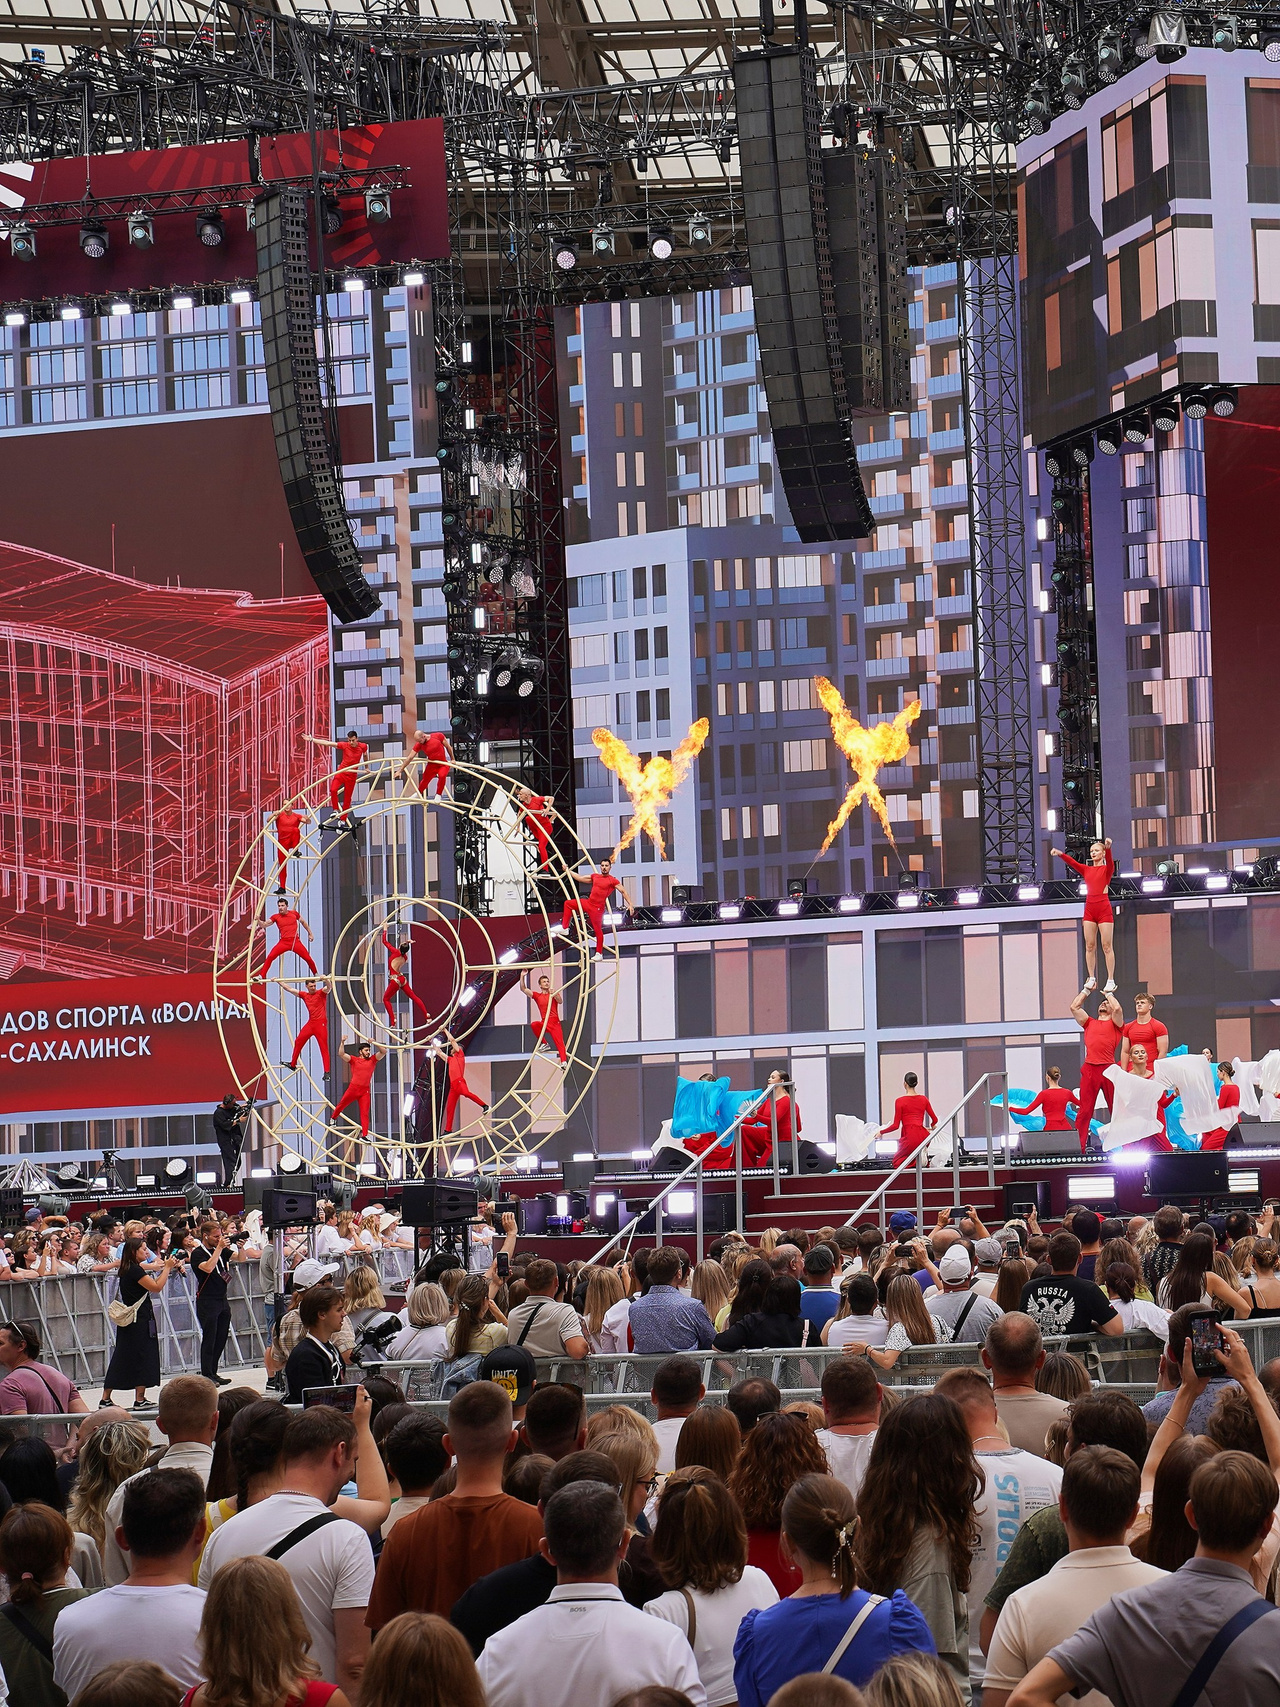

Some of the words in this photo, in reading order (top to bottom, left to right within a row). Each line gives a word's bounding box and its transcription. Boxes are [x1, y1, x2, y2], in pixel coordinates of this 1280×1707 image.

[55, 1004, 146, 1030] СПОРТА
[0, 1035, 152, 1064] -САХАЛИНСК
[1037, 1286, 1069, 1299] RUSSIA
[993, 1473, 1020, 1579] POLIS
